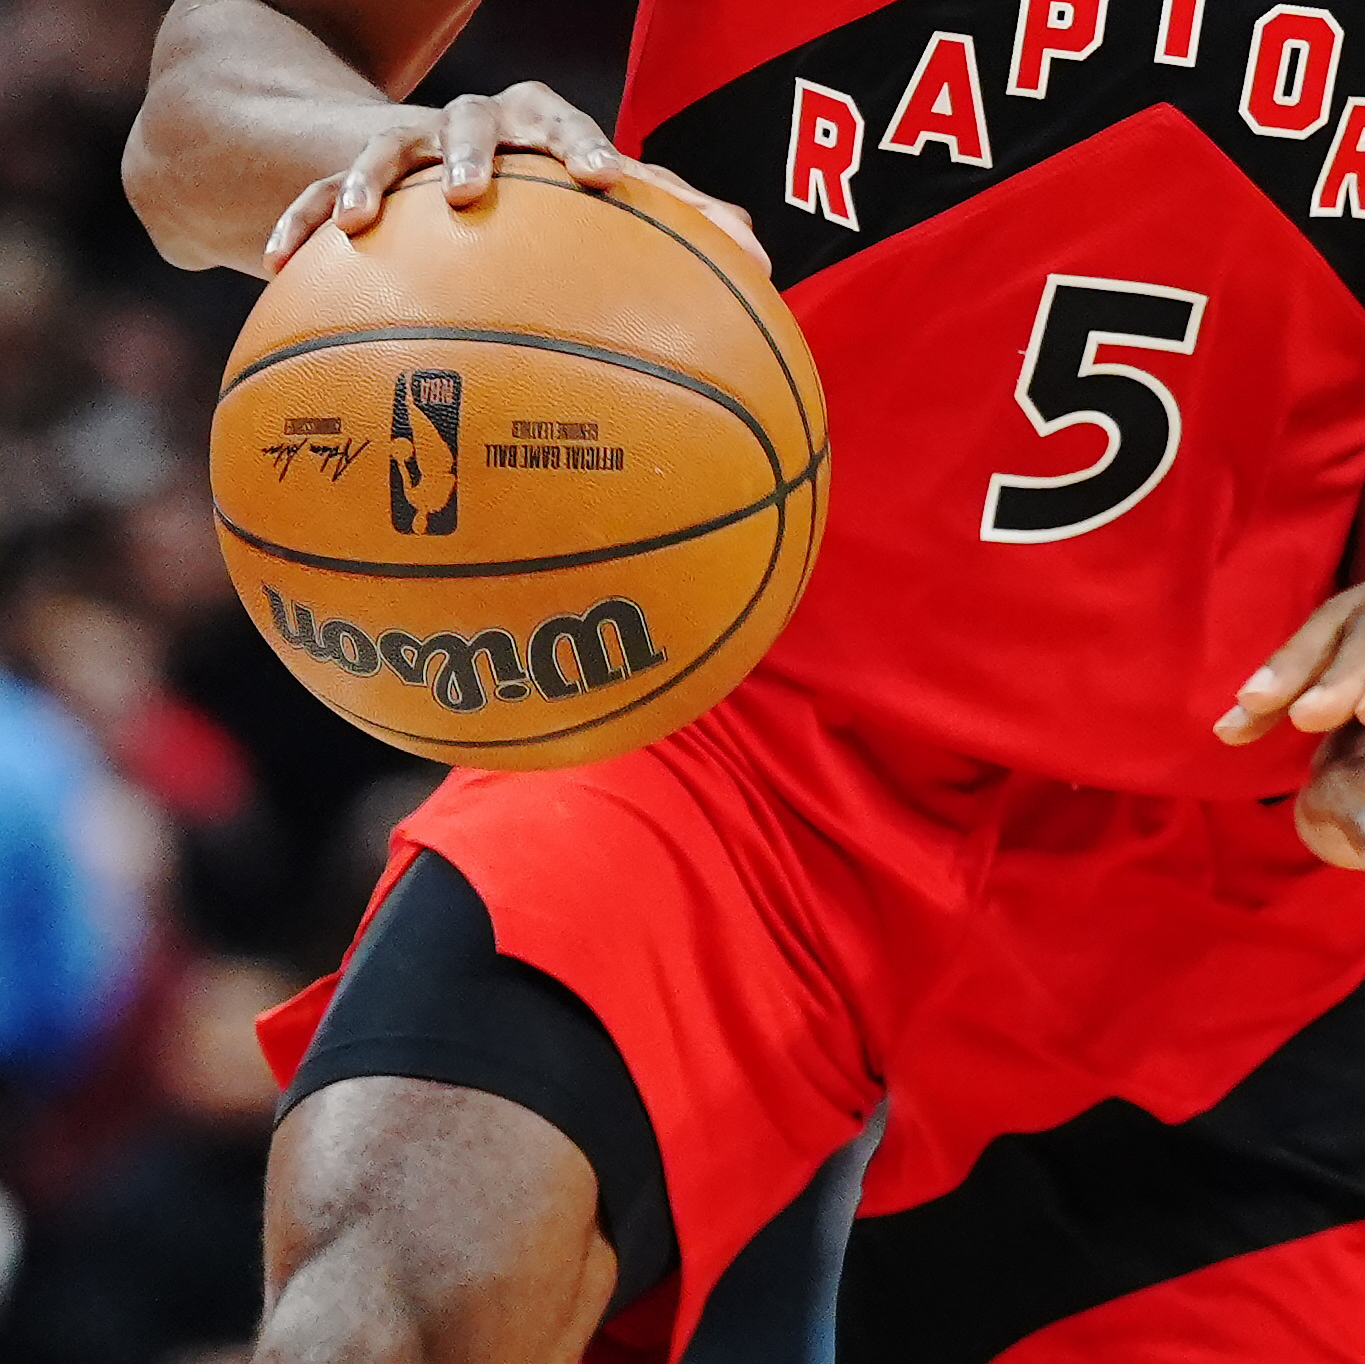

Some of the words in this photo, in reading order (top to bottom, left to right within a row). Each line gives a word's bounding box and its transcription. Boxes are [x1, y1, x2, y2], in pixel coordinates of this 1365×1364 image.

[420, 377, 454, 406] NBA
[980, 273, 1208, 544] 5
[484, 444, 517, 469] BALL
[522, 445, 561, 470] GAME
[564, 445, 624, 471] OFFICIAL
[262, 584, 668, 713] Wilson
